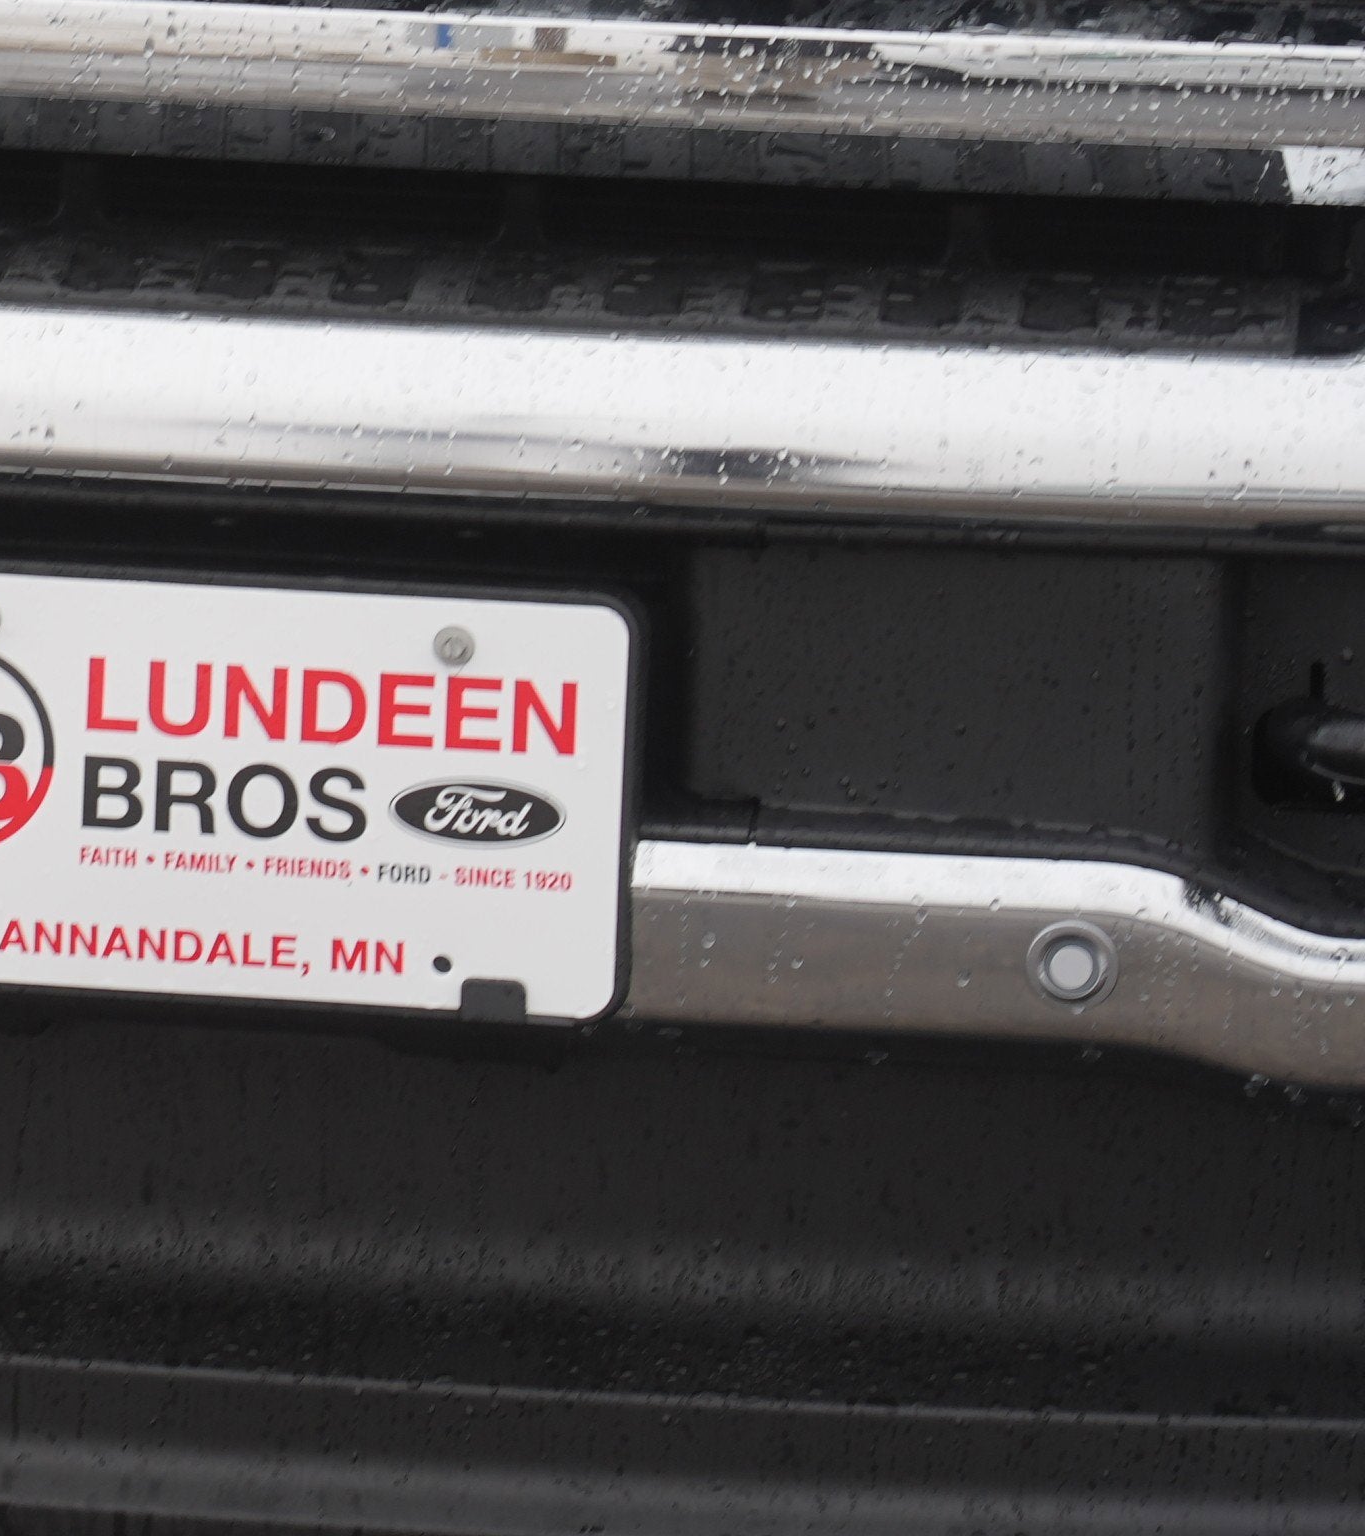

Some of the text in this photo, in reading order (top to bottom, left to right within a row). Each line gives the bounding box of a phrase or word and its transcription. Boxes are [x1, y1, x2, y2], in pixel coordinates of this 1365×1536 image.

[85, 656, 579, 757] LUNDEEN
[81, 754, 368, 844] BROS
[423, 785, 534, 837] Ford
[80, 846, 573, 891] FAITH FAMILY FRIENDS FORD SINCE 1920
[329, 937, 405, 975] MN
